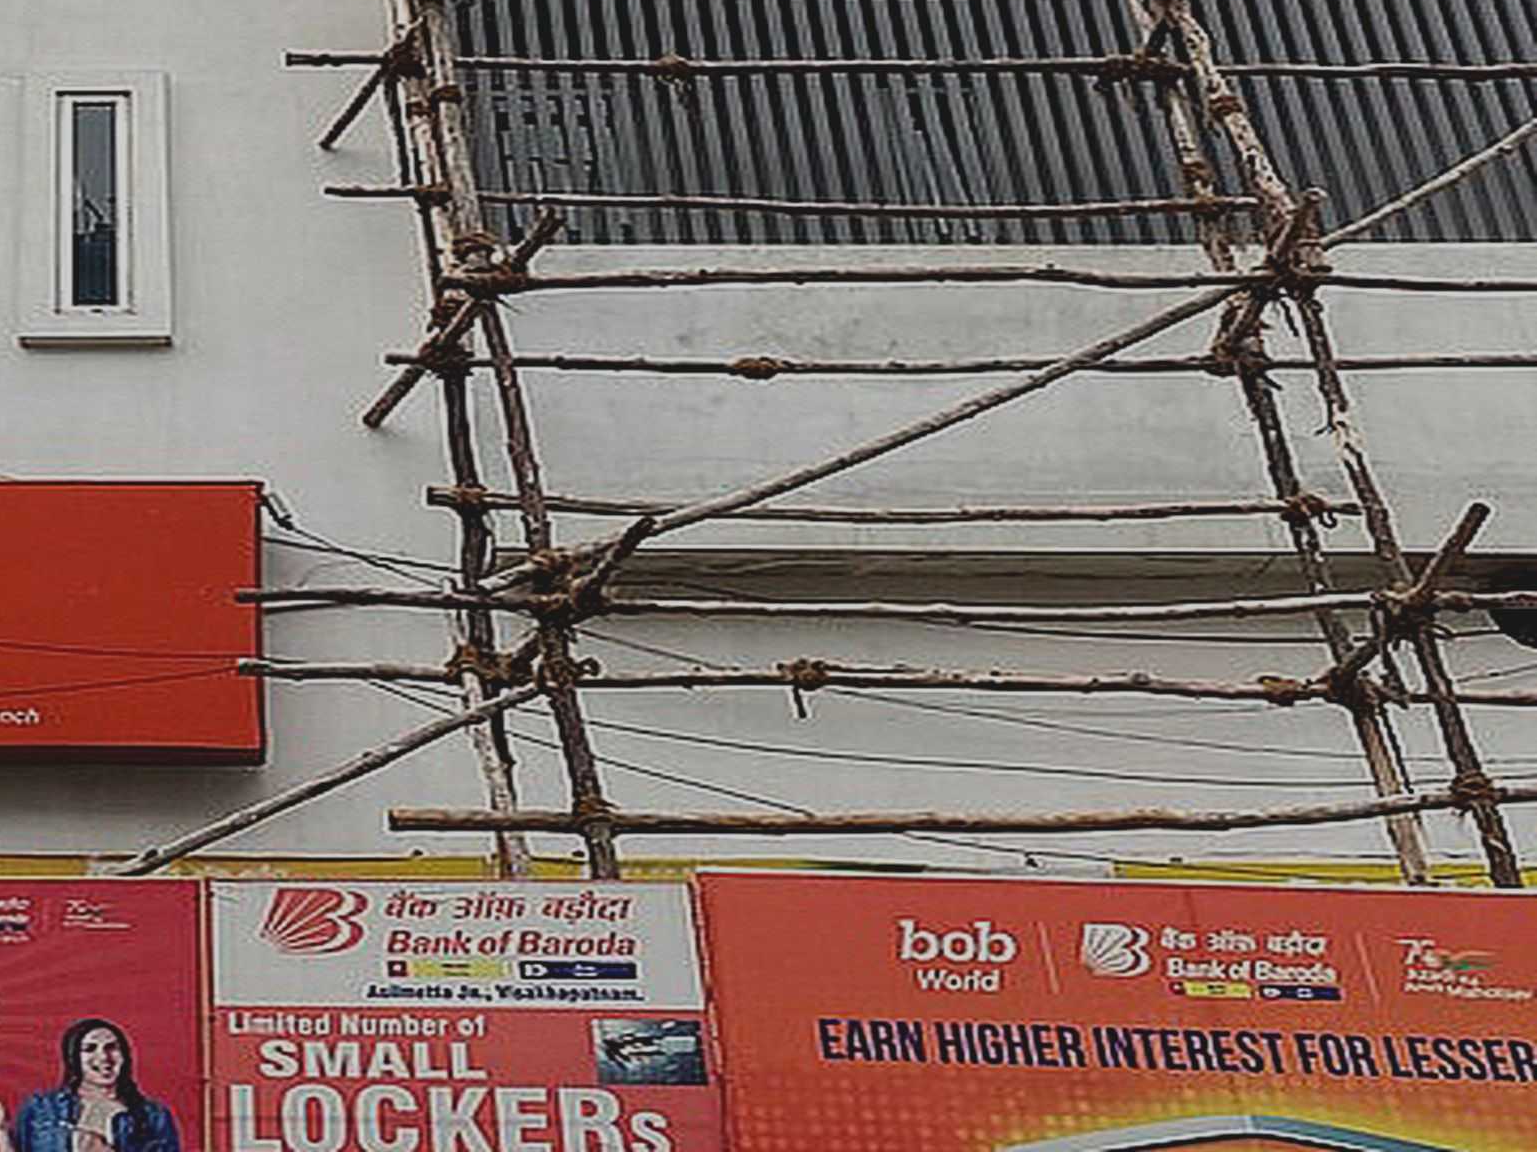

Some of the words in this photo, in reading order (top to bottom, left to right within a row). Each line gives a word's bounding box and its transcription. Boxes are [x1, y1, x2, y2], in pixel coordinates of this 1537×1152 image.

[384, 890, 438, 920] बैंक
[541, 889, 634, 925] बड़ौदा
[387, 930, 473, 956] Bank
[478, 930, 514, 956] of
[517, 930, 637, 957] Baroda
[898, 919, 1017, 963] bob
[916, 968, 1001, 992] World
[1165, 956, 1226, 978] Bank
[1229, 958, 1252, 980] of
[1254, 959, 1339, 983] Baroda
[228, 1013, 329, 1036] Limited
[340, 1014, 447, 1037] Number
[457, 1014, 486, 1037] of
[260, 1039, 489, 1080] SMALL
[817, 1017, 928, 1063] EARN
[935, 1021, 1088, 1070] HIGHER
[1092, 1025, 1283, 1075] INTEREST
[1295, 1032, 1381, 1079] FOR
[1382, 1035, 1537, 1085] LESSER
